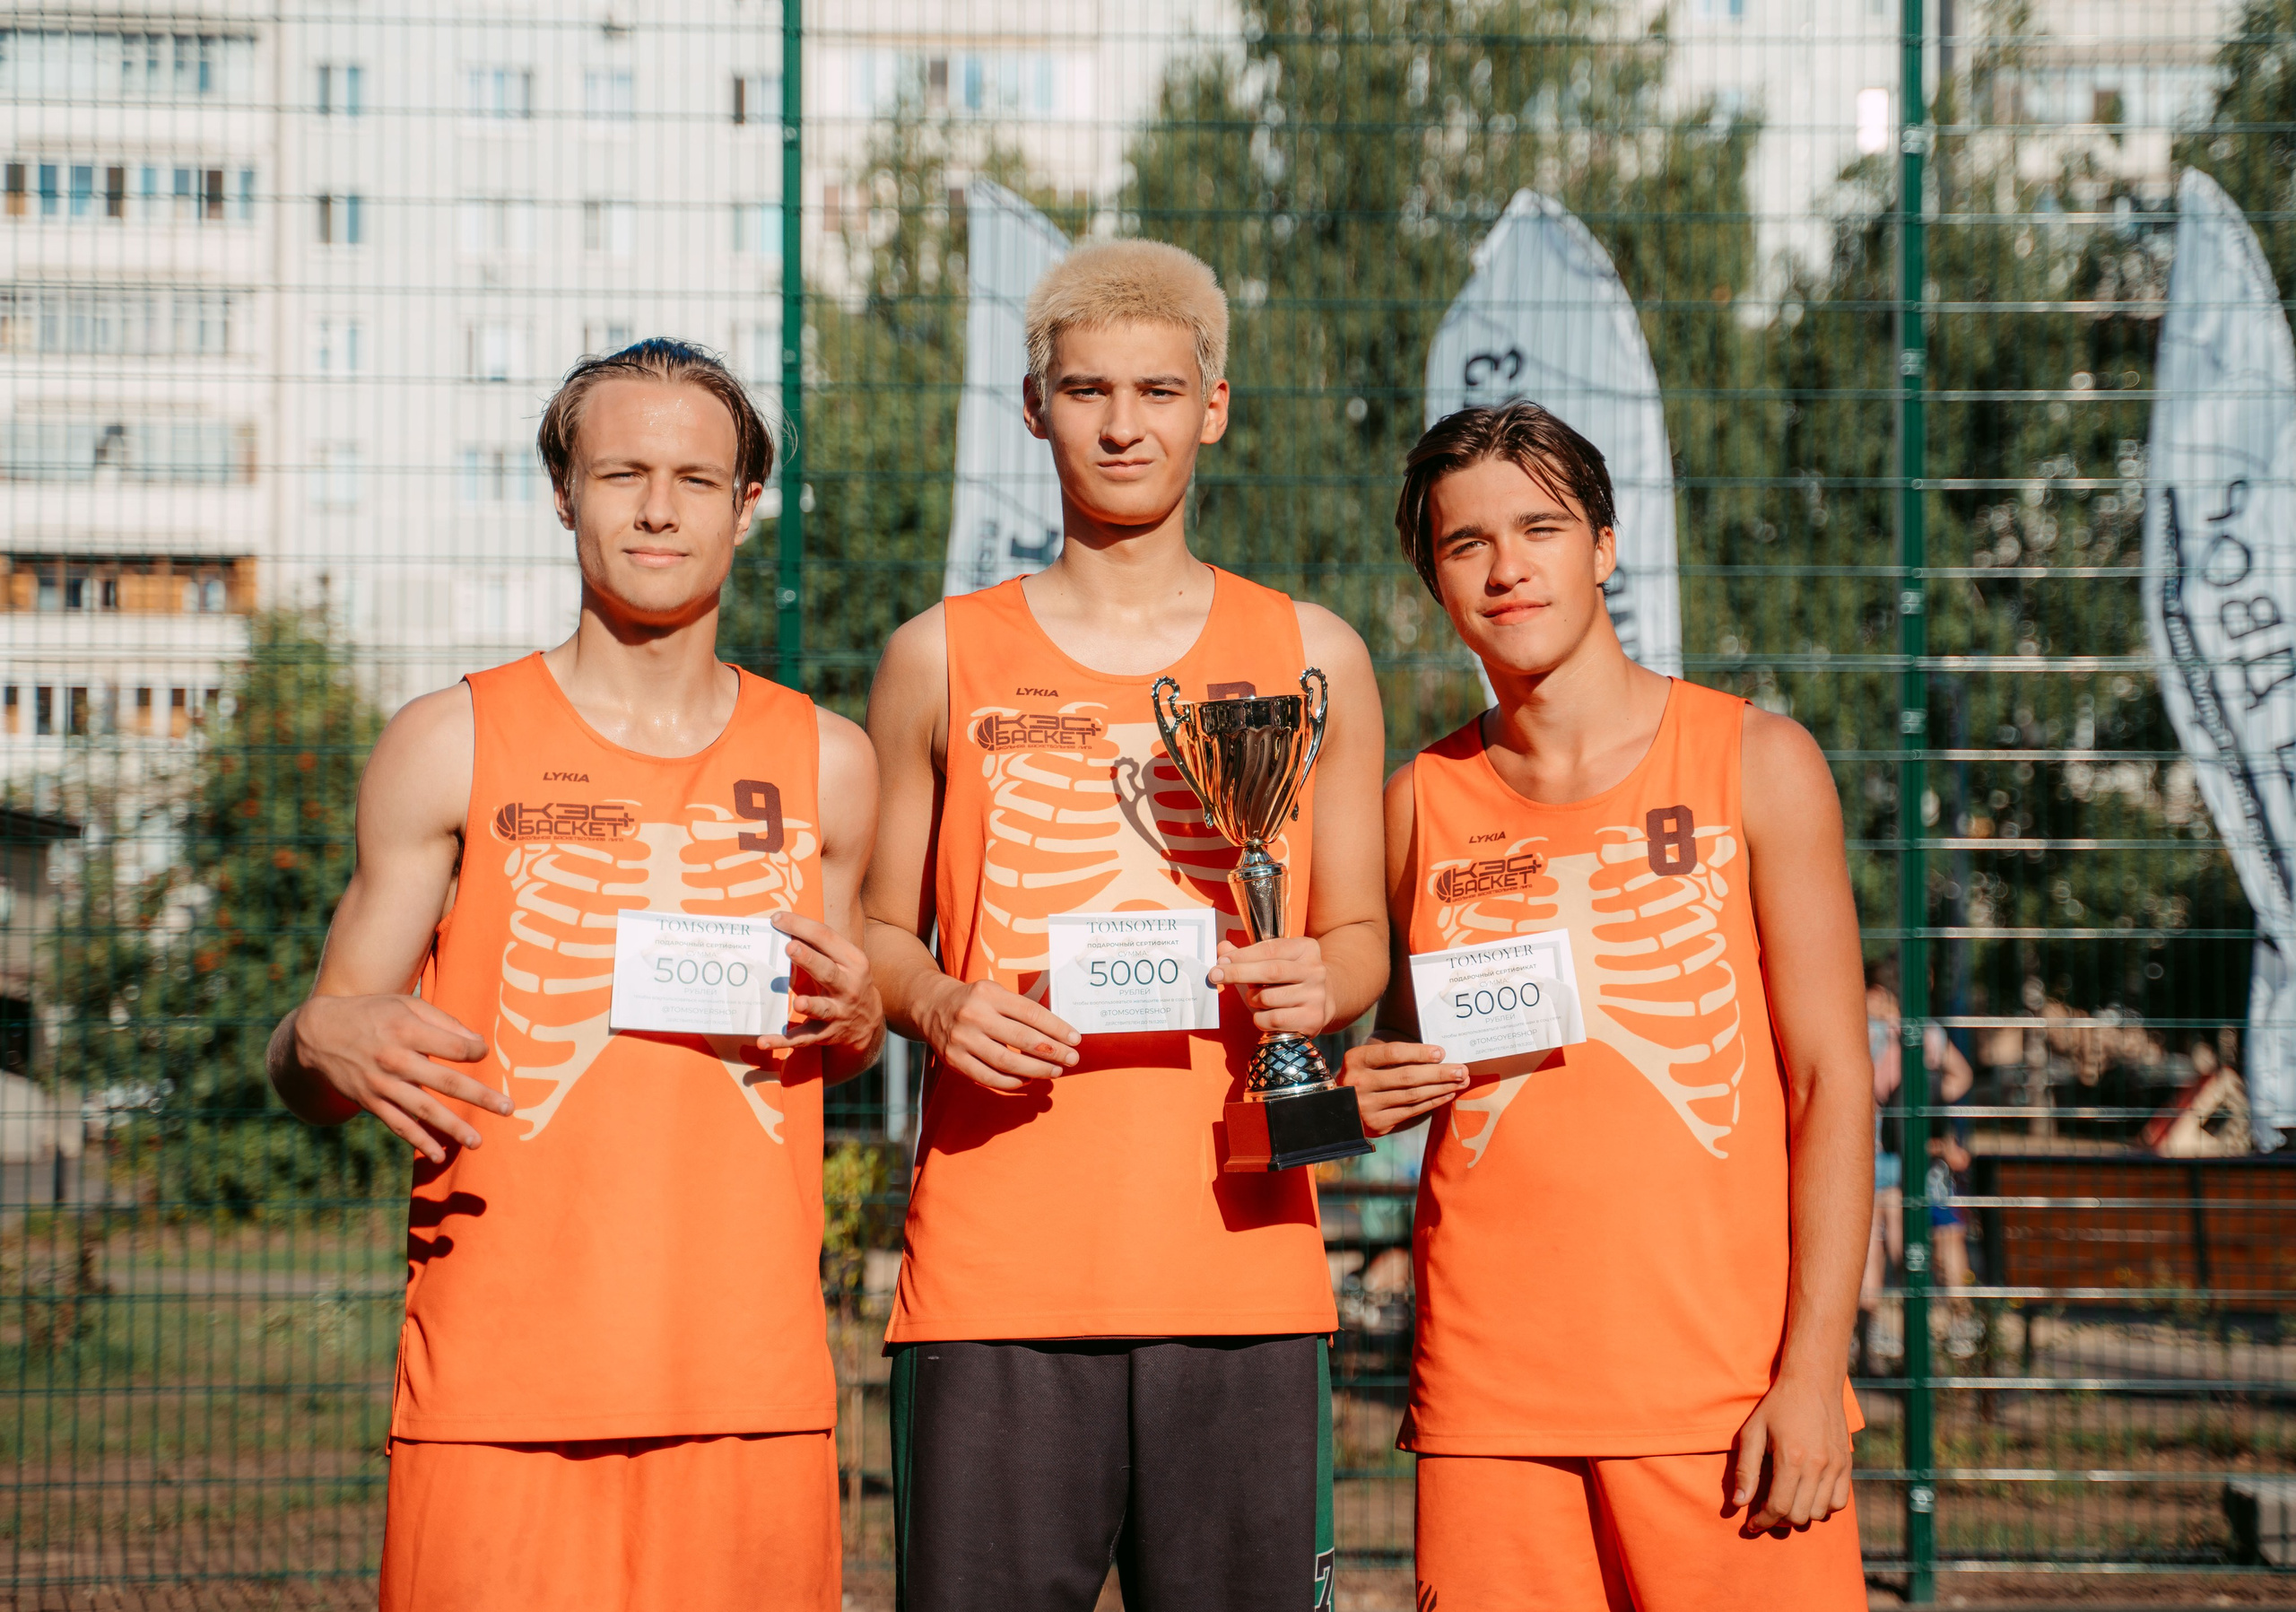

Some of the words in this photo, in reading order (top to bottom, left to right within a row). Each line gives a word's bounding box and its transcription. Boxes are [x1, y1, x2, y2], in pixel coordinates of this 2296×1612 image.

[1015, 687, 1058, 697] LYKIA
[543, 771, 590, 782] LYKIA
[734, 779, 785, 854] 9
[1469, 831, 1507, 843] LYKIA
[1646, 805, 1698, 876] 8
[656, 918, 751, 936] TOMSOYER
[1086, 919, 1178, 934] TOMSOYER
[655, 939, 704, 948] ПОДАРОЧНЫЙ
[706, 942, 751, 950] СЕРТИФИКАТ
[1446, 944, 1534, 969] TOMSOYER
[654, 957, 749, 987] 5000
[1090, 958, 1178, 987] 5000
[1449, 971, 1494, 983] ПОДАРОЧНЫЙ
[1495, 963, 1537, 976] СЕРТИФИКАТ
[684, 987, 718, 996] РУБЛЕЙ
[1118, 988, 1151, 997] РУБЛЕЙ
[1456, 982, 1540, 1018] 5000
[662, 1006, 737, 1015] @TOMSOYERSHOP
[1100, 1007, 1171, 1017] @TOMSOYERSHOP
[1485, 1014, 1516, 1024] РУБЛЕЙ
[1469, 1028, 1537, 1048] @TOMSOYERSHOP
